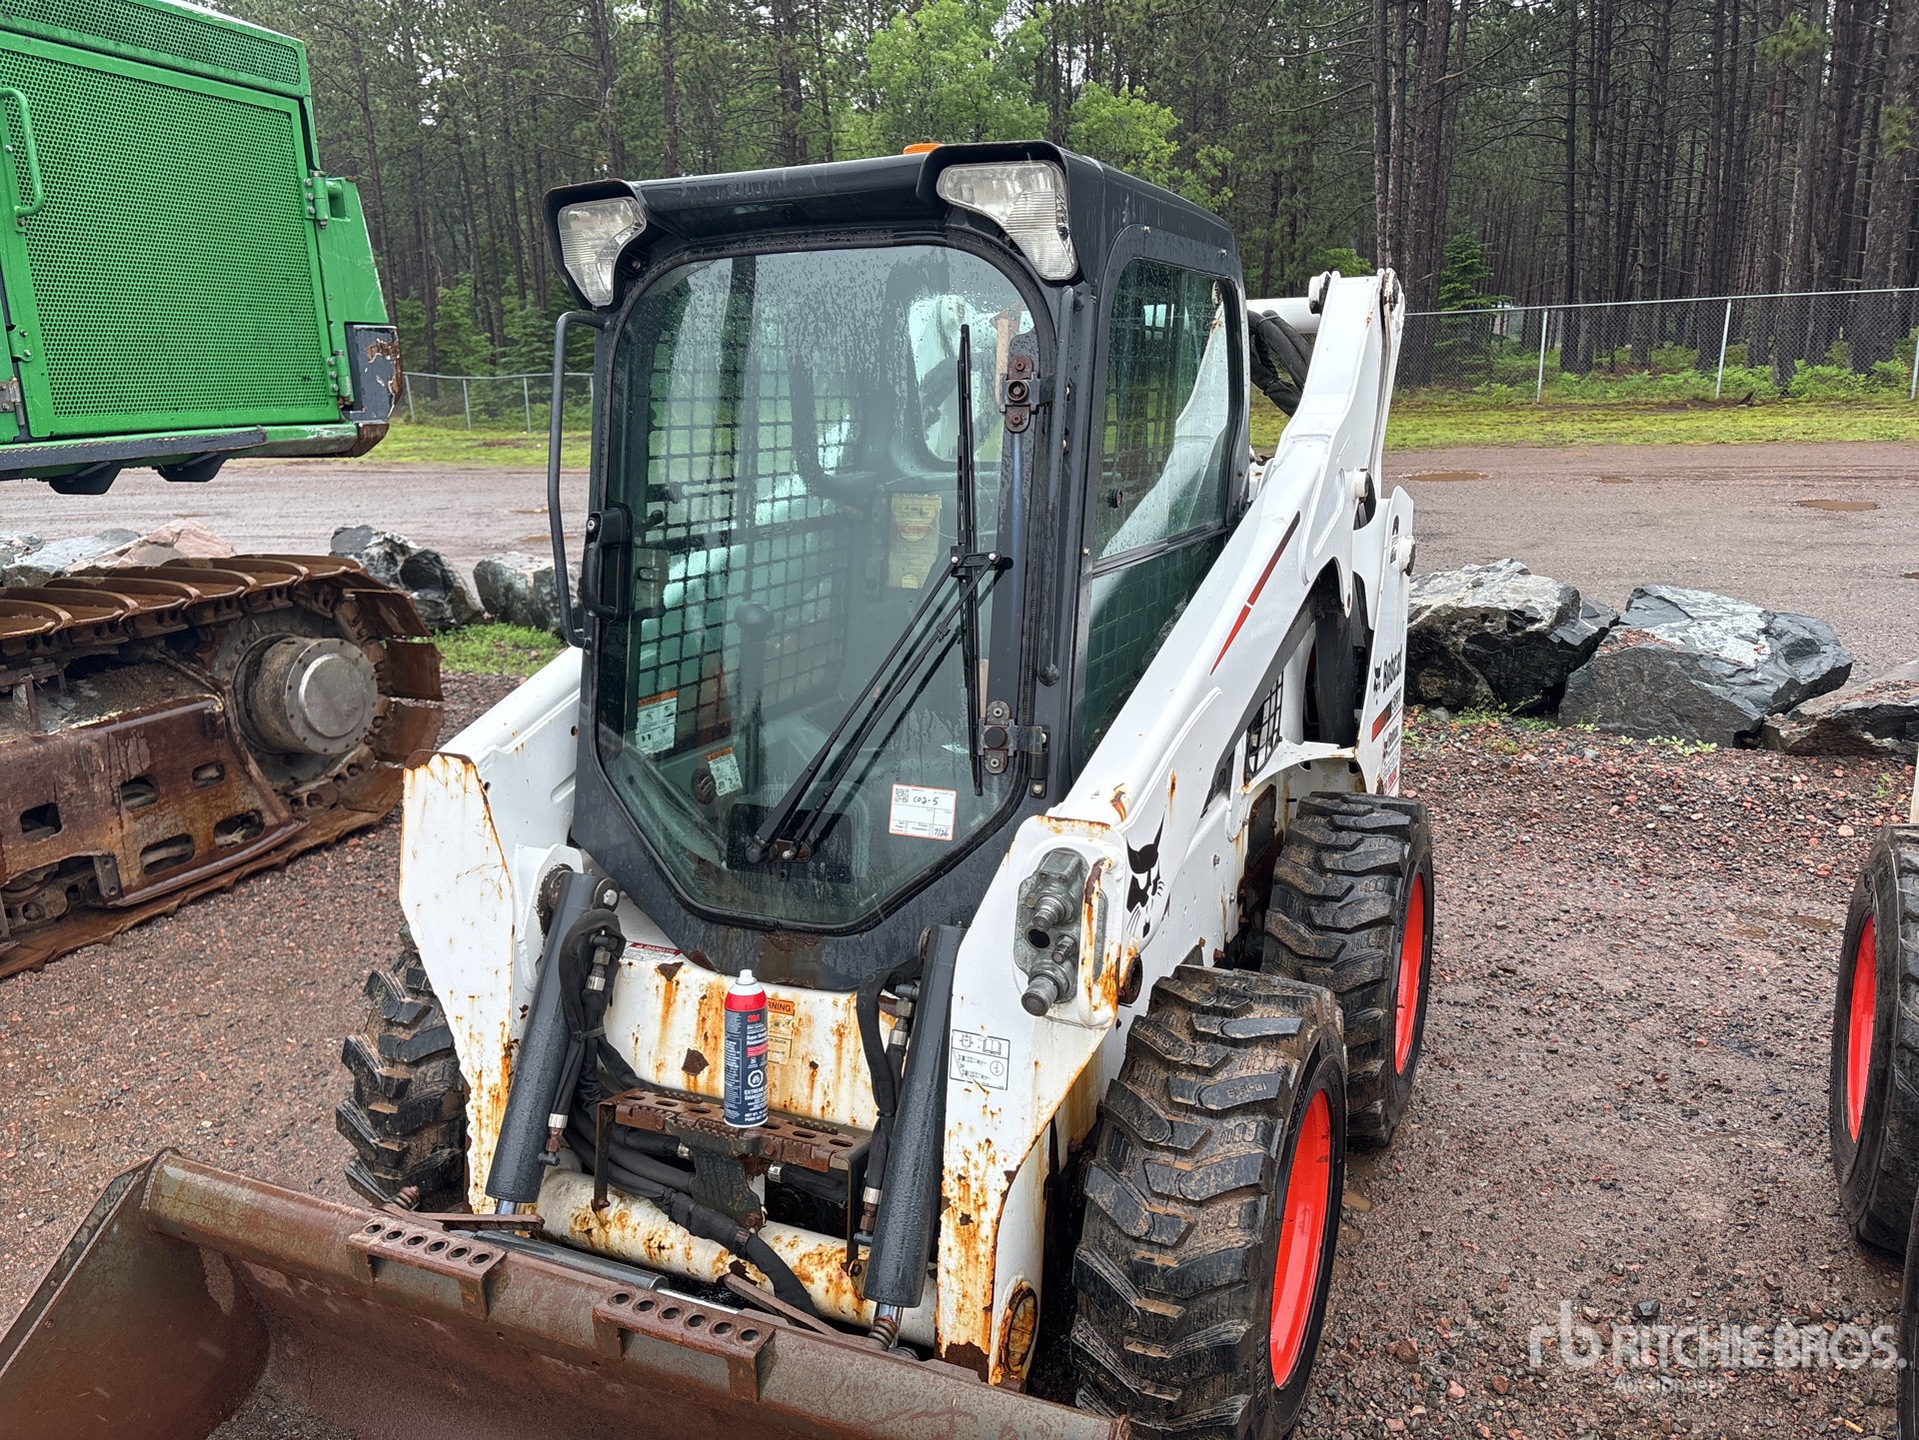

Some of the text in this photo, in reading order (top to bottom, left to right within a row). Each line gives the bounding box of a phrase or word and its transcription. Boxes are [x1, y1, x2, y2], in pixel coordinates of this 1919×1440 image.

[1383, 643, 1402, 694] Bobcat
[768, 1001, 791, 1012] RNING
[747, 1013, 760, 1023] 3M
